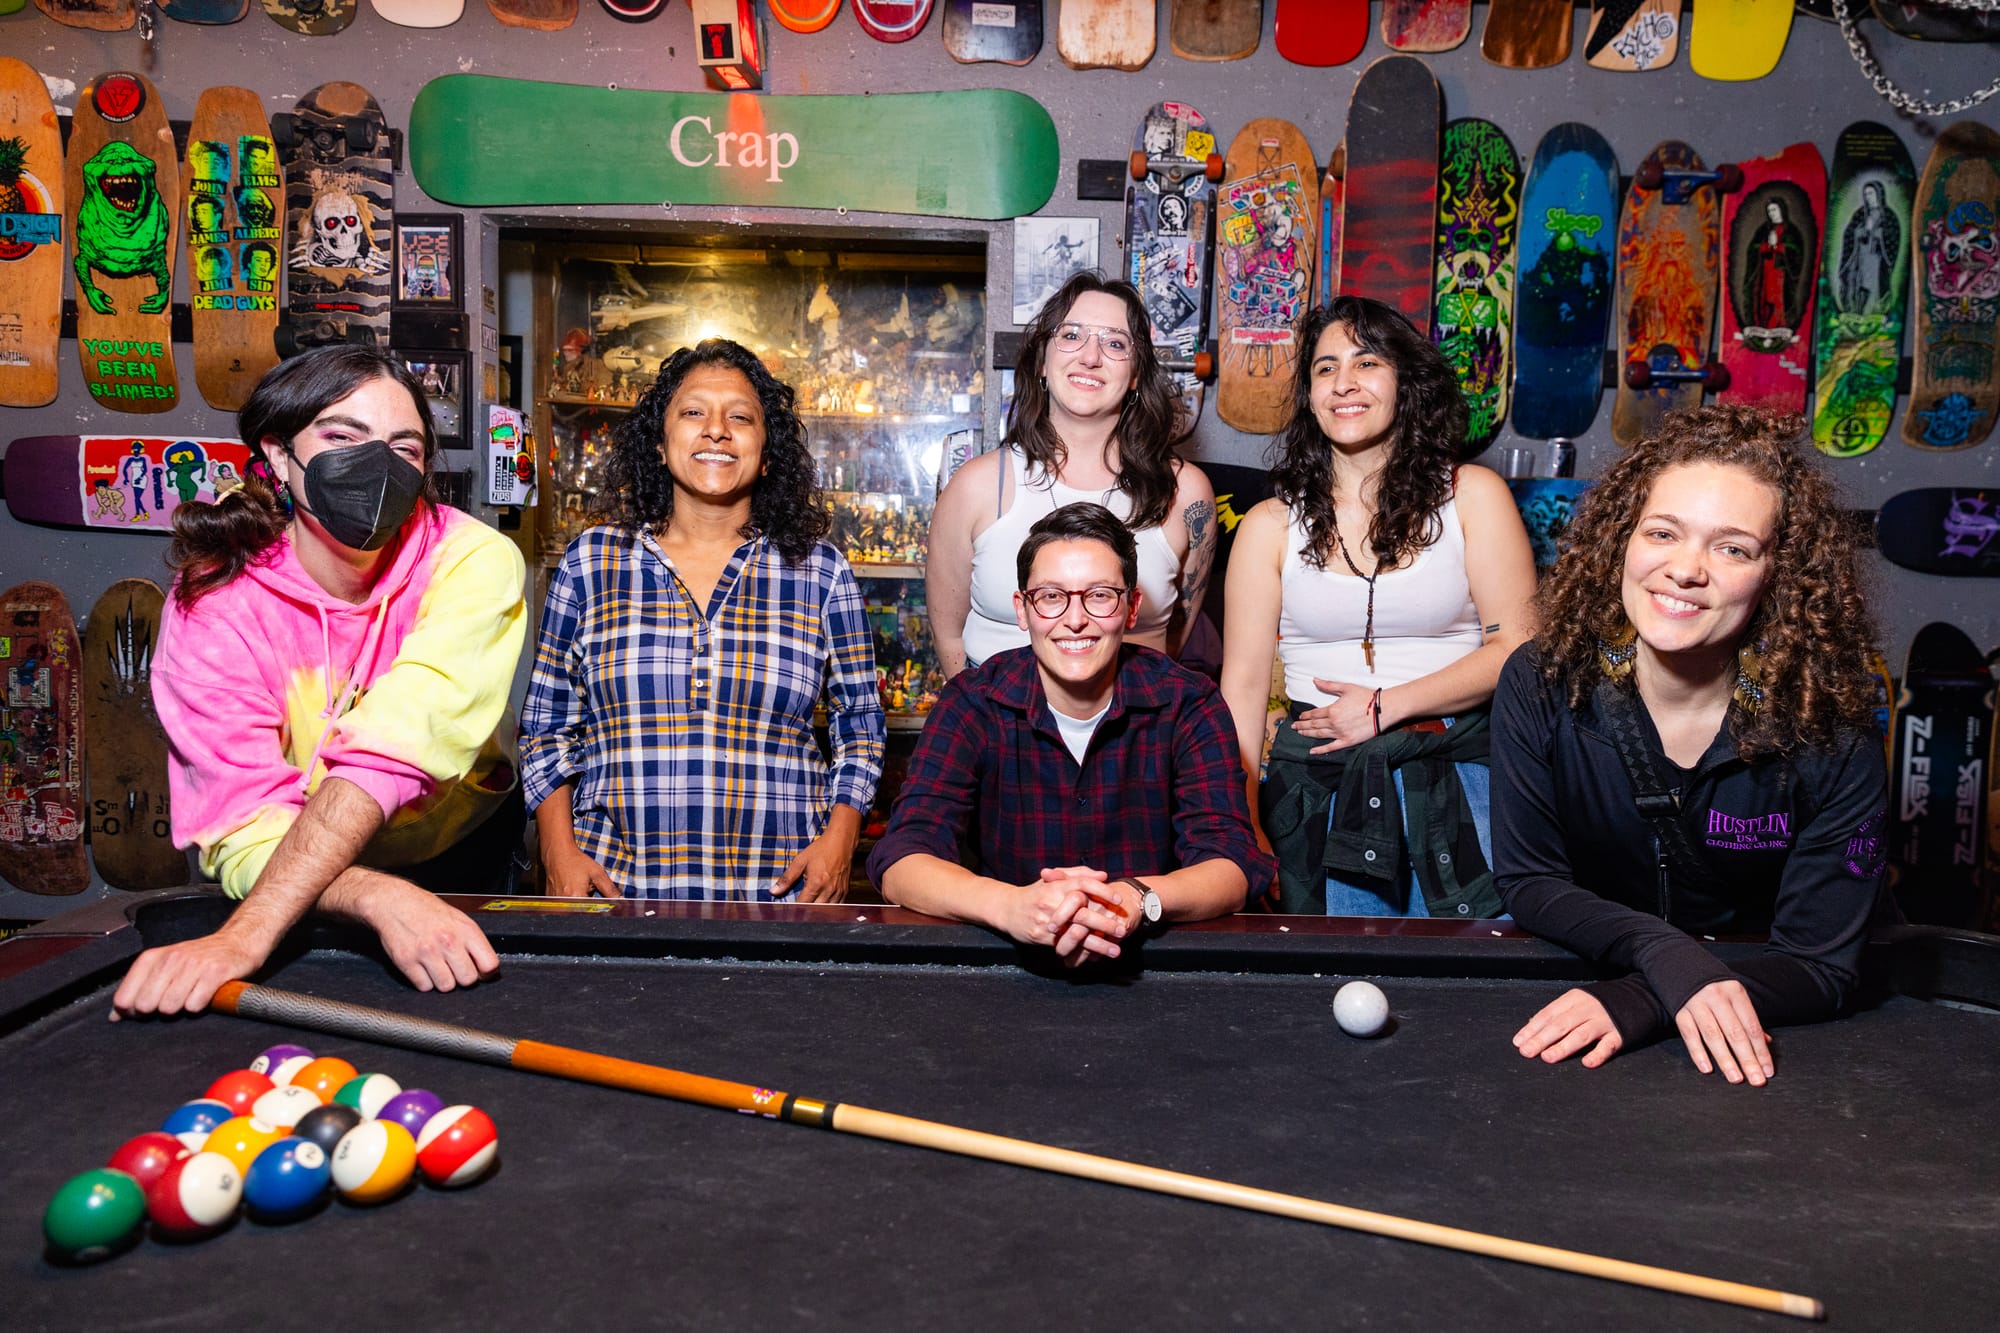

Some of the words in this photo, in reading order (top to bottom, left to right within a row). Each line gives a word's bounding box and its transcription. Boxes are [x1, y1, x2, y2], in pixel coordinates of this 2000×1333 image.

[670, 115, 799, 182] Crap
[234, 228, 280, 239] ALBERT
[248, 281, 272, 291] SID
[193, 295, 234, 310] DEAD
[235, 295, 276, 310] GUYS
[82, 338, 165, 358] YOU'VE
[97, 360, 157, 383] BEEN
[89, 382, 175, 400] SLIMED!
[1736, 834, 1758, 843] USA
